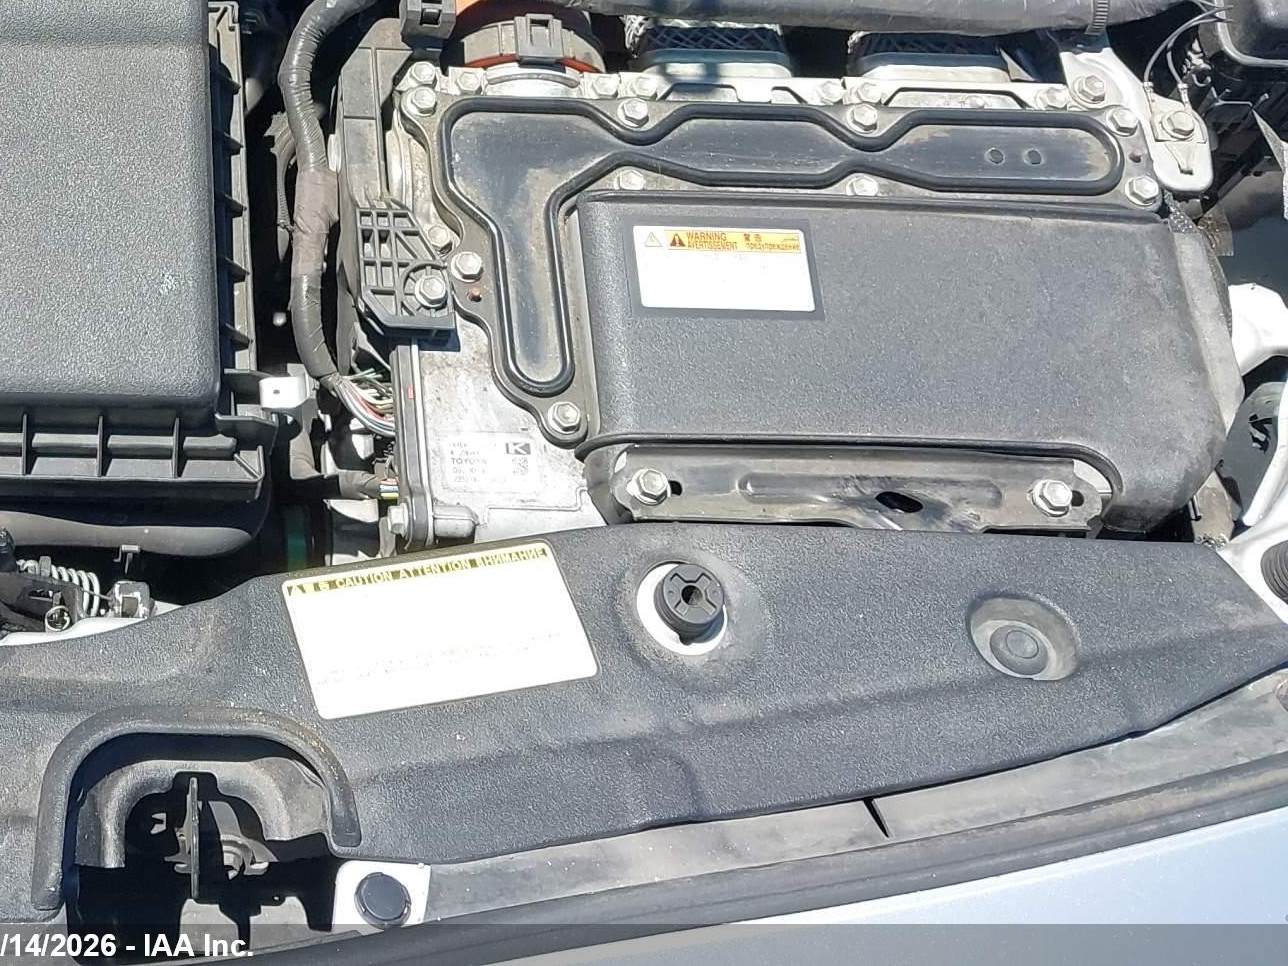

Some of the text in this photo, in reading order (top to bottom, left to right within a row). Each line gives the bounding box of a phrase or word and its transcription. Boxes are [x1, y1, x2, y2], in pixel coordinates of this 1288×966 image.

[686, 231, 727, 241] WARNING
[687, 240, 738, 251] AVERTISSEMENT
[335, 571, 394, 589] CAUTION
[398, 559, 471, 580] ATTENTION
